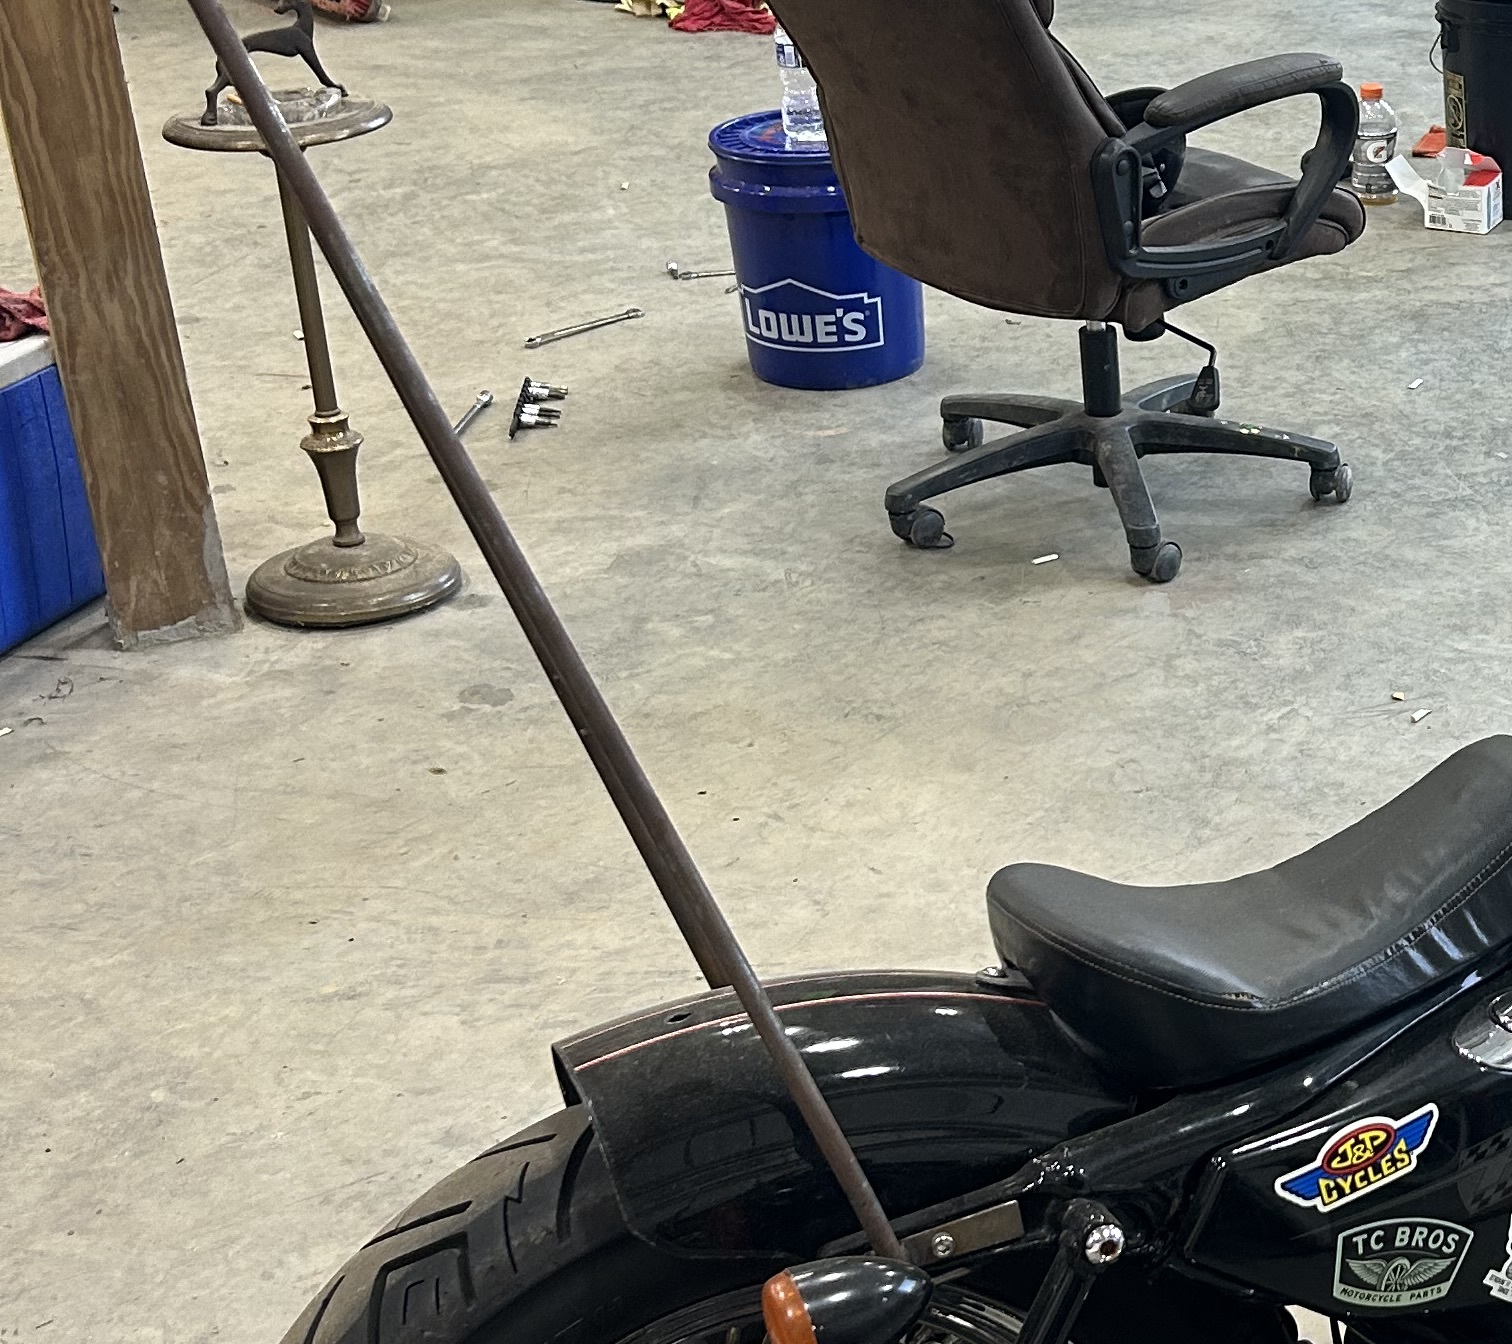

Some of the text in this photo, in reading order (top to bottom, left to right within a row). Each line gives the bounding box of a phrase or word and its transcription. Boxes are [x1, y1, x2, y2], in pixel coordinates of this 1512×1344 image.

[745, 297, 867, 343] LOWE'S
[1330, 1129, 1388, 1169] J&P
[1318, 1137, 1412, 1205] CYCLES
[1352, 1226, 1460, 1255] TC BROS
[1340, 1287, 1442, 1303] MOTORCYCLE PARTS
